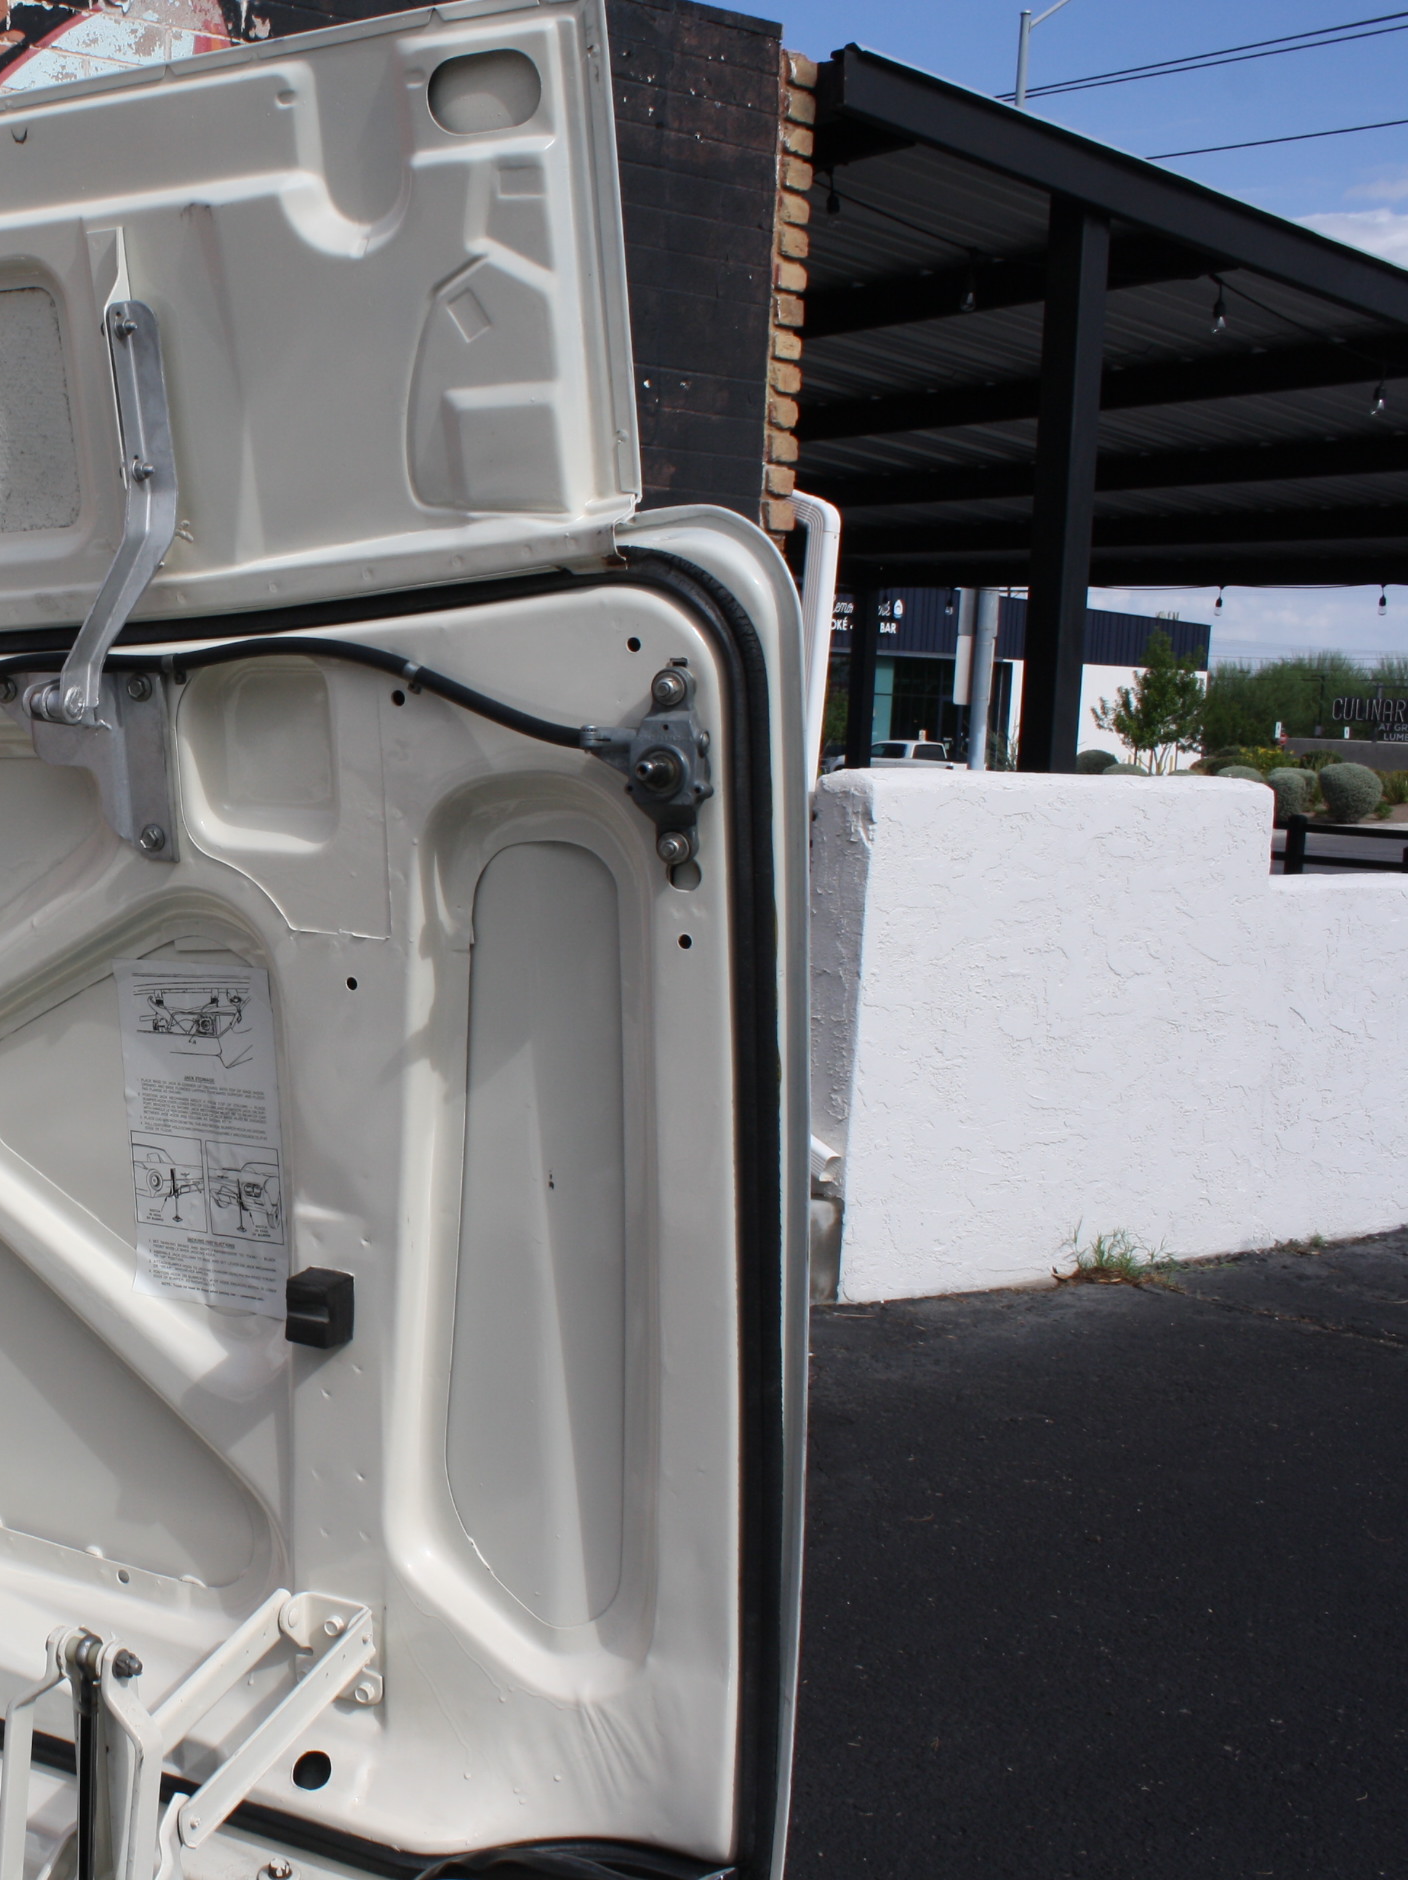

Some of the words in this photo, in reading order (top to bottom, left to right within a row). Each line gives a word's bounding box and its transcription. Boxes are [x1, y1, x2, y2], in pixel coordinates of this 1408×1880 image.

[831, 616, 848, 631] OKÉ
[879, 622, 897, 634] BAR
[1332, 697, 1407, 722] CULINAR
